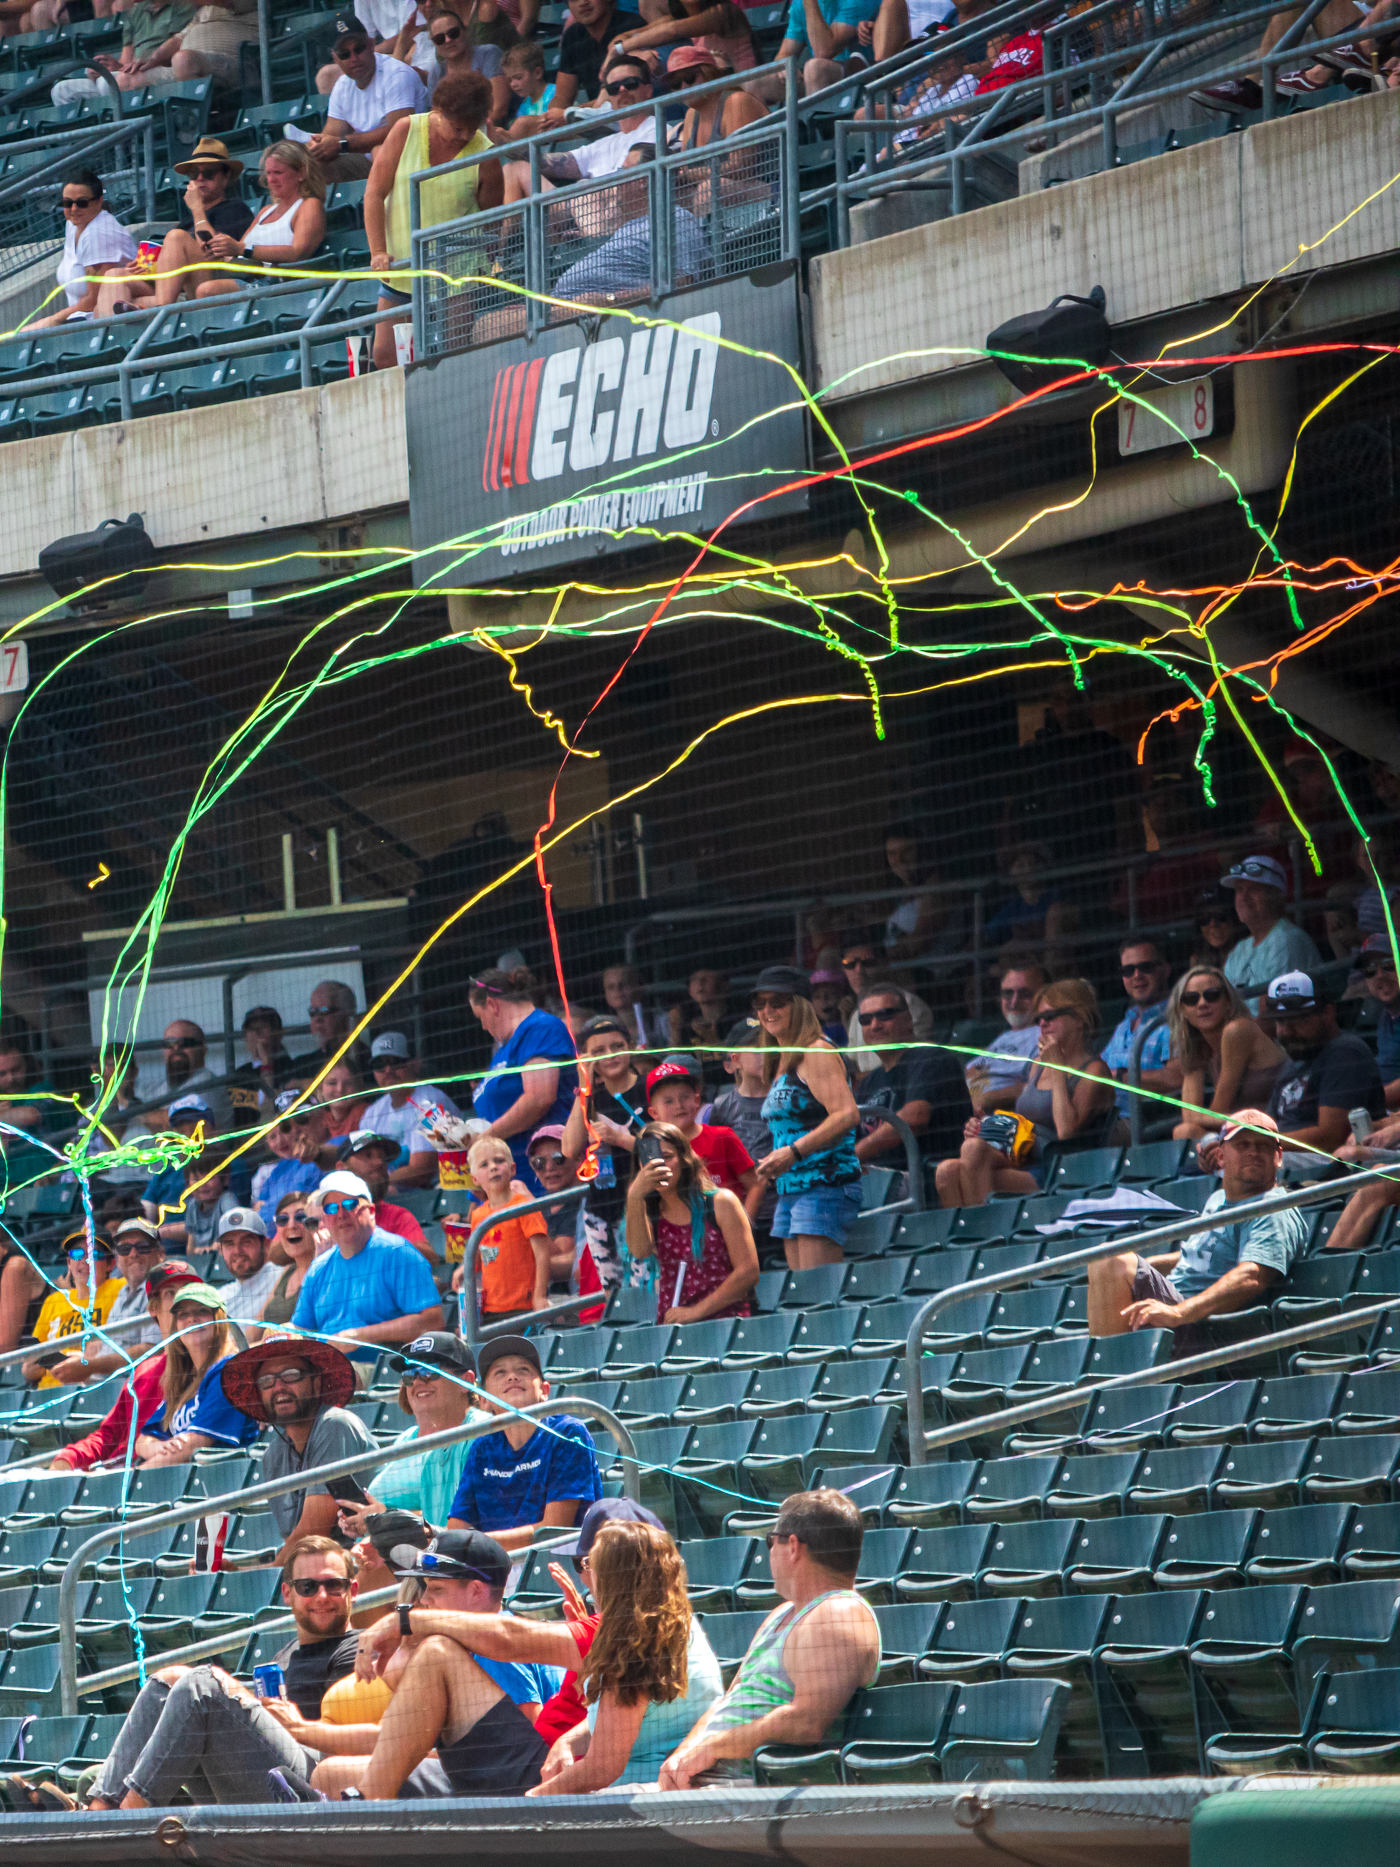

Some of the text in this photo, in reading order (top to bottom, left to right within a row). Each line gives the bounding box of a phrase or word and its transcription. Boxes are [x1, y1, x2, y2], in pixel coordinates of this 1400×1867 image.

[530, 311, 721, 480] ECHO
[1124, 385, 1206, 448] 7 8
[501, 471, 708, 557] OUTDOOR POWER EQUIPMENT
[4, 647, 19, 686] 7
